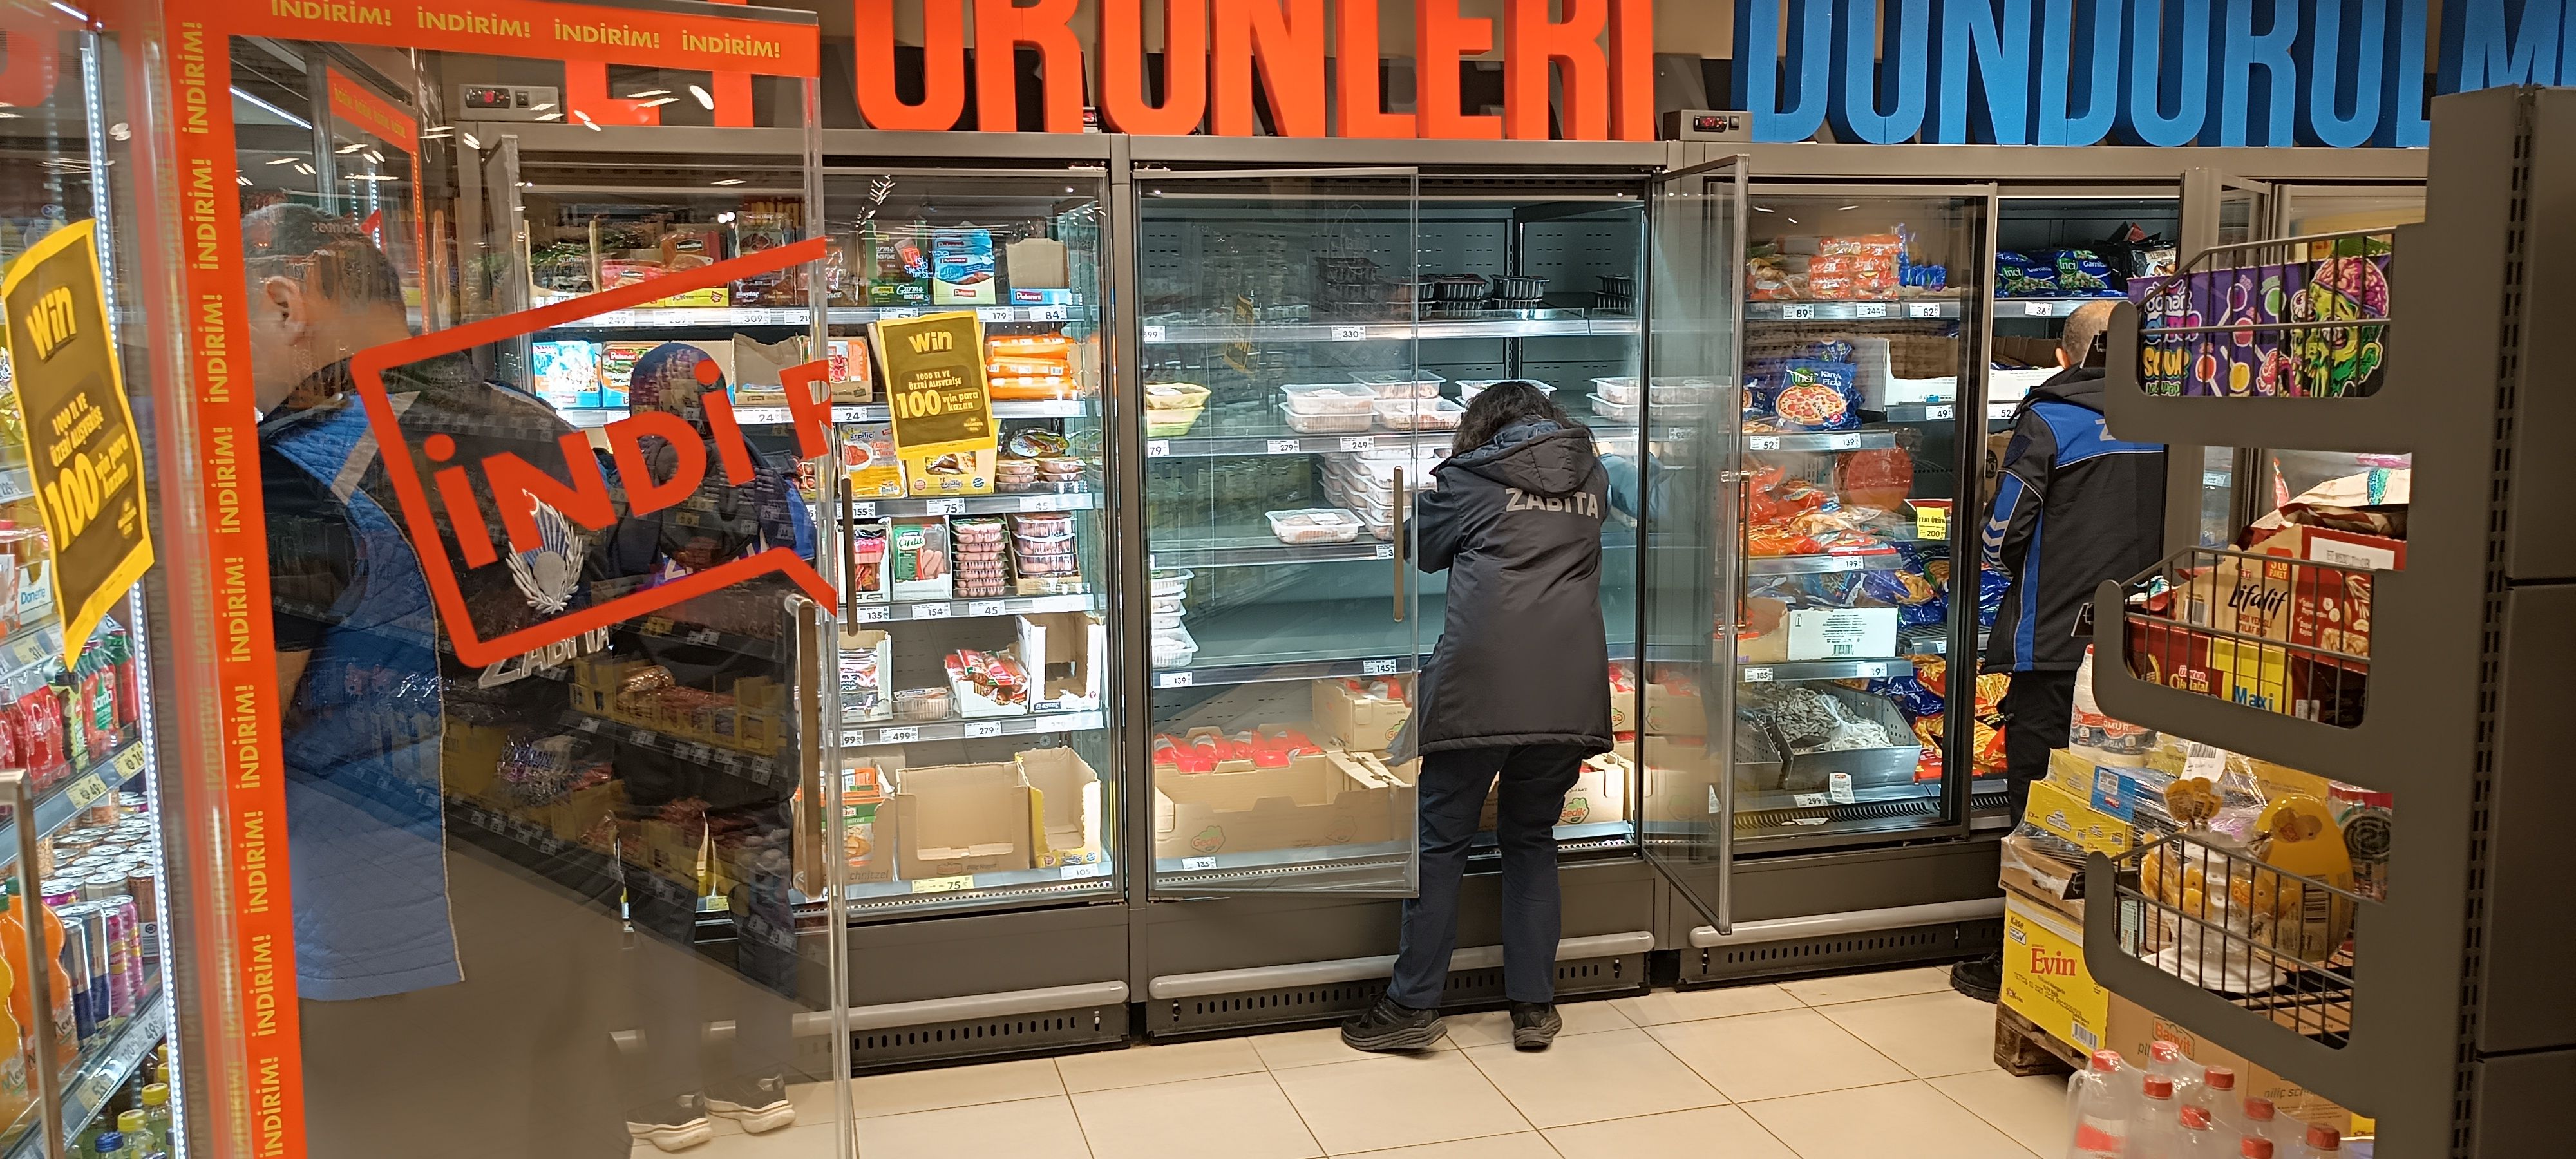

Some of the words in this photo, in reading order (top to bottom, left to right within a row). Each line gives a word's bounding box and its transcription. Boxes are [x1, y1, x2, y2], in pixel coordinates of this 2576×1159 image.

[418, 6, 530, 39] İNDİRİM!
[554, 18, 660, 50] İNDİRİM!
[682, 29, 781, 59] İNDİRİM!
[182, 22, 208, 134] İNDİRİM!
[193, 159, 220, 270] İNDİRİM!
[2059, 259, 2076, 270] inci
[2004, 267, 2022, 277] inci
[1016, 292, 1042, 301] Polonez
[1045, 311, 1059, 320] 84
[1796, 308, 1808, 318] 89
[1923, 308, 1934, 317] 82
[744, 315, 762, 323] 309
[1343, 330, 1359, 339] 330
[204, 294, 229, 403] İNDİRİM!
[916, 371, 933, 381] 1000
[909, 380, 927, 390] ÜZERİ
[929, 377, 962, 388] ALIŞVERİŞE
[959, 391, 979, 402] para
[896, 390, 942, 419] 100
[947, 401, 973, 411] kazan
[759, 414, 773, 422] 24
[846, 412, 860, 420] 24
[1937, 410, 1948, 419] 49
[2001, 410, 2011, 418] 52
[1763, 441, 1774, 449] 52
[1150, 446, 1162, 455] 79
[214, 427, 240, 534] İNDİRİM!
[44, 453, 99, 551] 100
[944, 504, 958, 513] 75
[21, 587, 46, 604] Danette
[225, 557, 251, 663] İNDİRİM!
[927, 608, 943, 616] 154
[985, 606, 998, 614] 45
[1376, 664, 1390, 673] 145
[1174, 676, 1186, 684] 139
[1756, 672, 1768, 680] 185
[2235, 685, 2273, 711] Maxi
[979, 726, 994, 735] 279
[231, 685, 260, 789] İNDİRİM!
[893, 732, 911, 740] 499
[1807, 797, 1821, 806] 299
[1192, 836, 1222, 849] Gedik
[240, 811, 268, 914] İNDİRİM!
[849, 869, 889, 881] chnitzel
[947, 881, 961, 890] 75
[2010, 915, 2024, 929] Kase
[2031, 948, 2076, 976] Evin
[249, 935, 276, 1037] İNDİRİM!
[257, 1057, 283, 1158] İNDİRİM!
